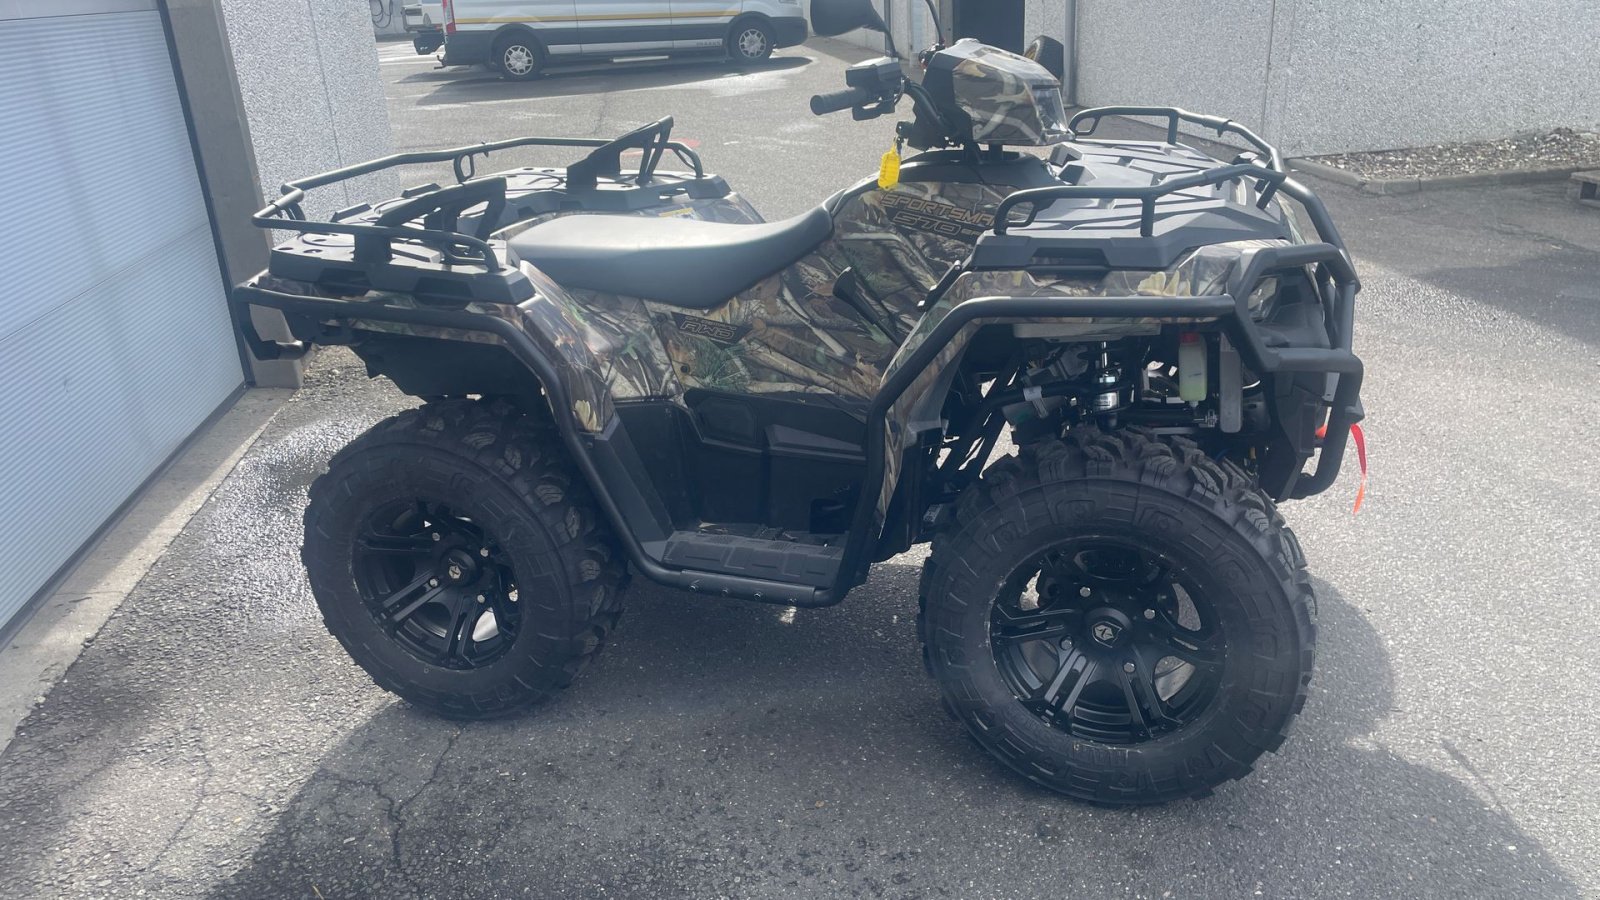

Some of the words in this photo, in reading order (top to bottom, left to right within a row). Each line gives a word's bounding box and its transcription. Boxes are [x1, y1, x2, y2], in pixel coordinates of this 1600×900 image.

[880, 193, 995, 226] SPORTSMA
[893, 211, 962, 236] 570
[680, 320, 735, 340] AWD
